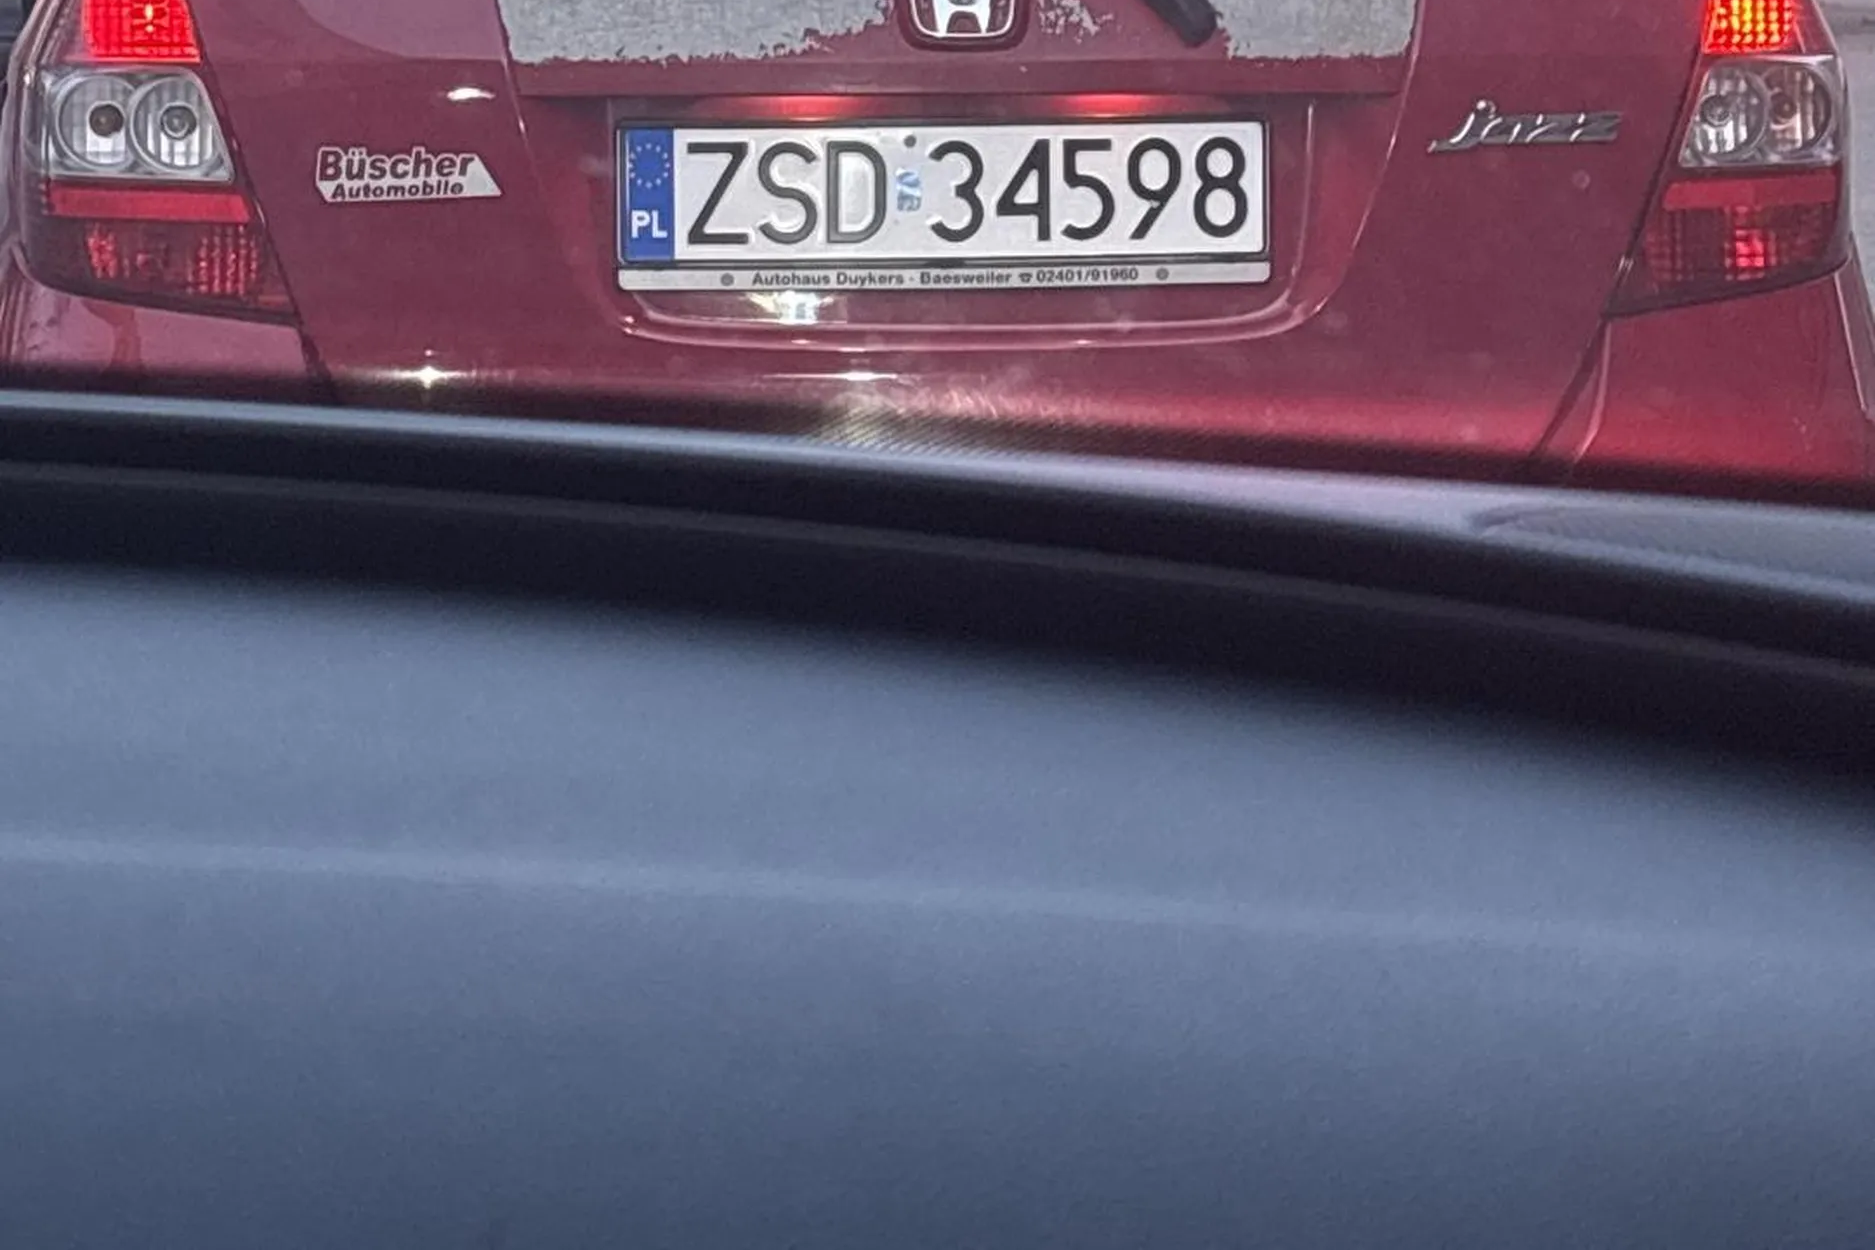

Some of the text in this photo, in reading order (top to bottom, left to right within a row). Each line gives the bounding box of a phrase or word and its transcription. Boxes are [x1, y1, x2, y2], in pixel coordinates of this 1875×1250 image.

[318, 149, 476, 182] Büscher
[331, 179, 465, 200] Automobile
[686, 137, 1249, 245] ZSD 34598
[631, 210, 668, 238] PL
[752, 267, 1139, 288] Autohaus Duykers Baesweiler 02401/91960
